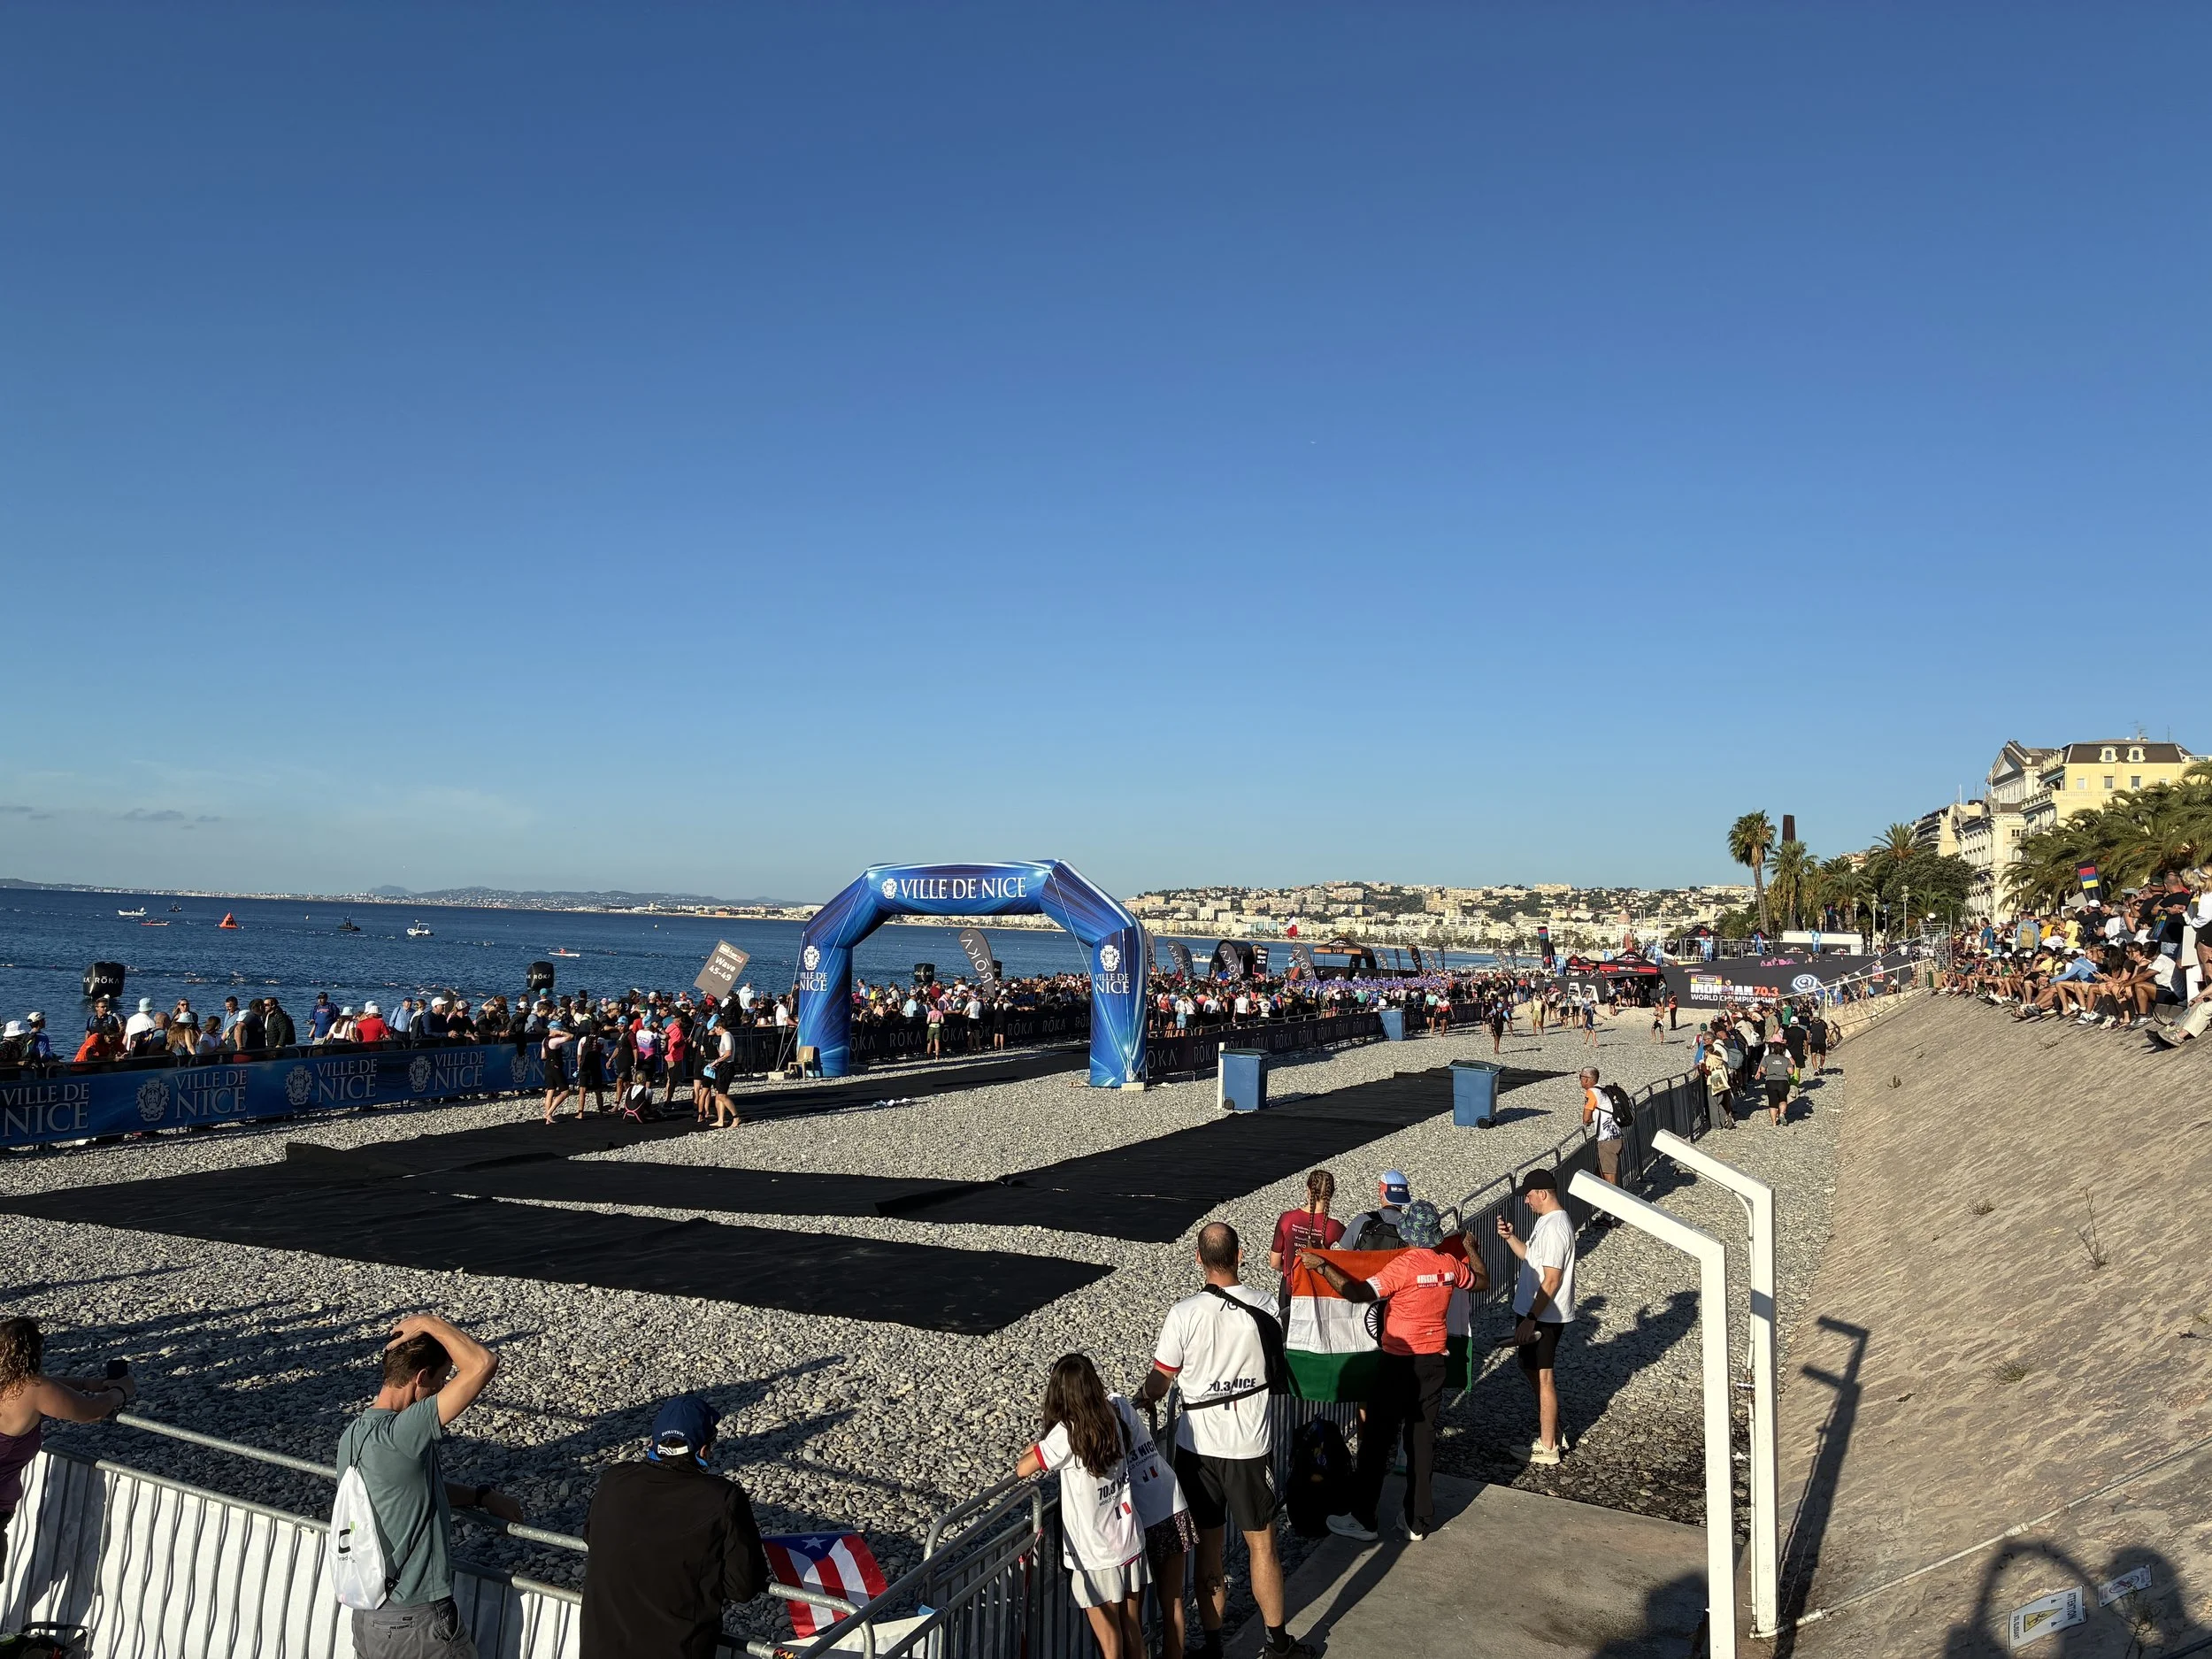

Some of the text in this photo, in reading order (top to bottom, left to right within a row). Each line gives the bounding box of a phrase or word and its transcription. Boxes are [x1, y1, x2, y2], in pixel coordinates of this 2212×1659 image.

[900, 877, 1027, 899] VILLE DE NICE
[709, 964, 733, 981] 45-49
[715, 956, 736, 972] Wave
[799, 979, 828, 991] NICE
[816, 972, 828, 980] DE
[1095, 980, 1130, 994] NICE
[1754, 986, 1779, 997] 70.3
[1691, 993, 1718, 1002] WORLD
[316, 1058, 378, 1077] VILLE DE
[434, 1050, 485, 1067] VILLE DE
[175, 1069, 248, 1091] VILLE DE
[434, 1064, 485, 1091] NICE
[3, 1082, 89, 1106] VILLE DE
[316, 1073, 378, 1102] NICE
[175, 1086, 247, 1119] NICE
[2, 1101, 88, 1138] NICE
[1233, 1378, 1256, 1389] NICE
[1097, 1480, 1116, 1500] 70.3
[2067, 1593, 2077, 1620] ATTENTION
